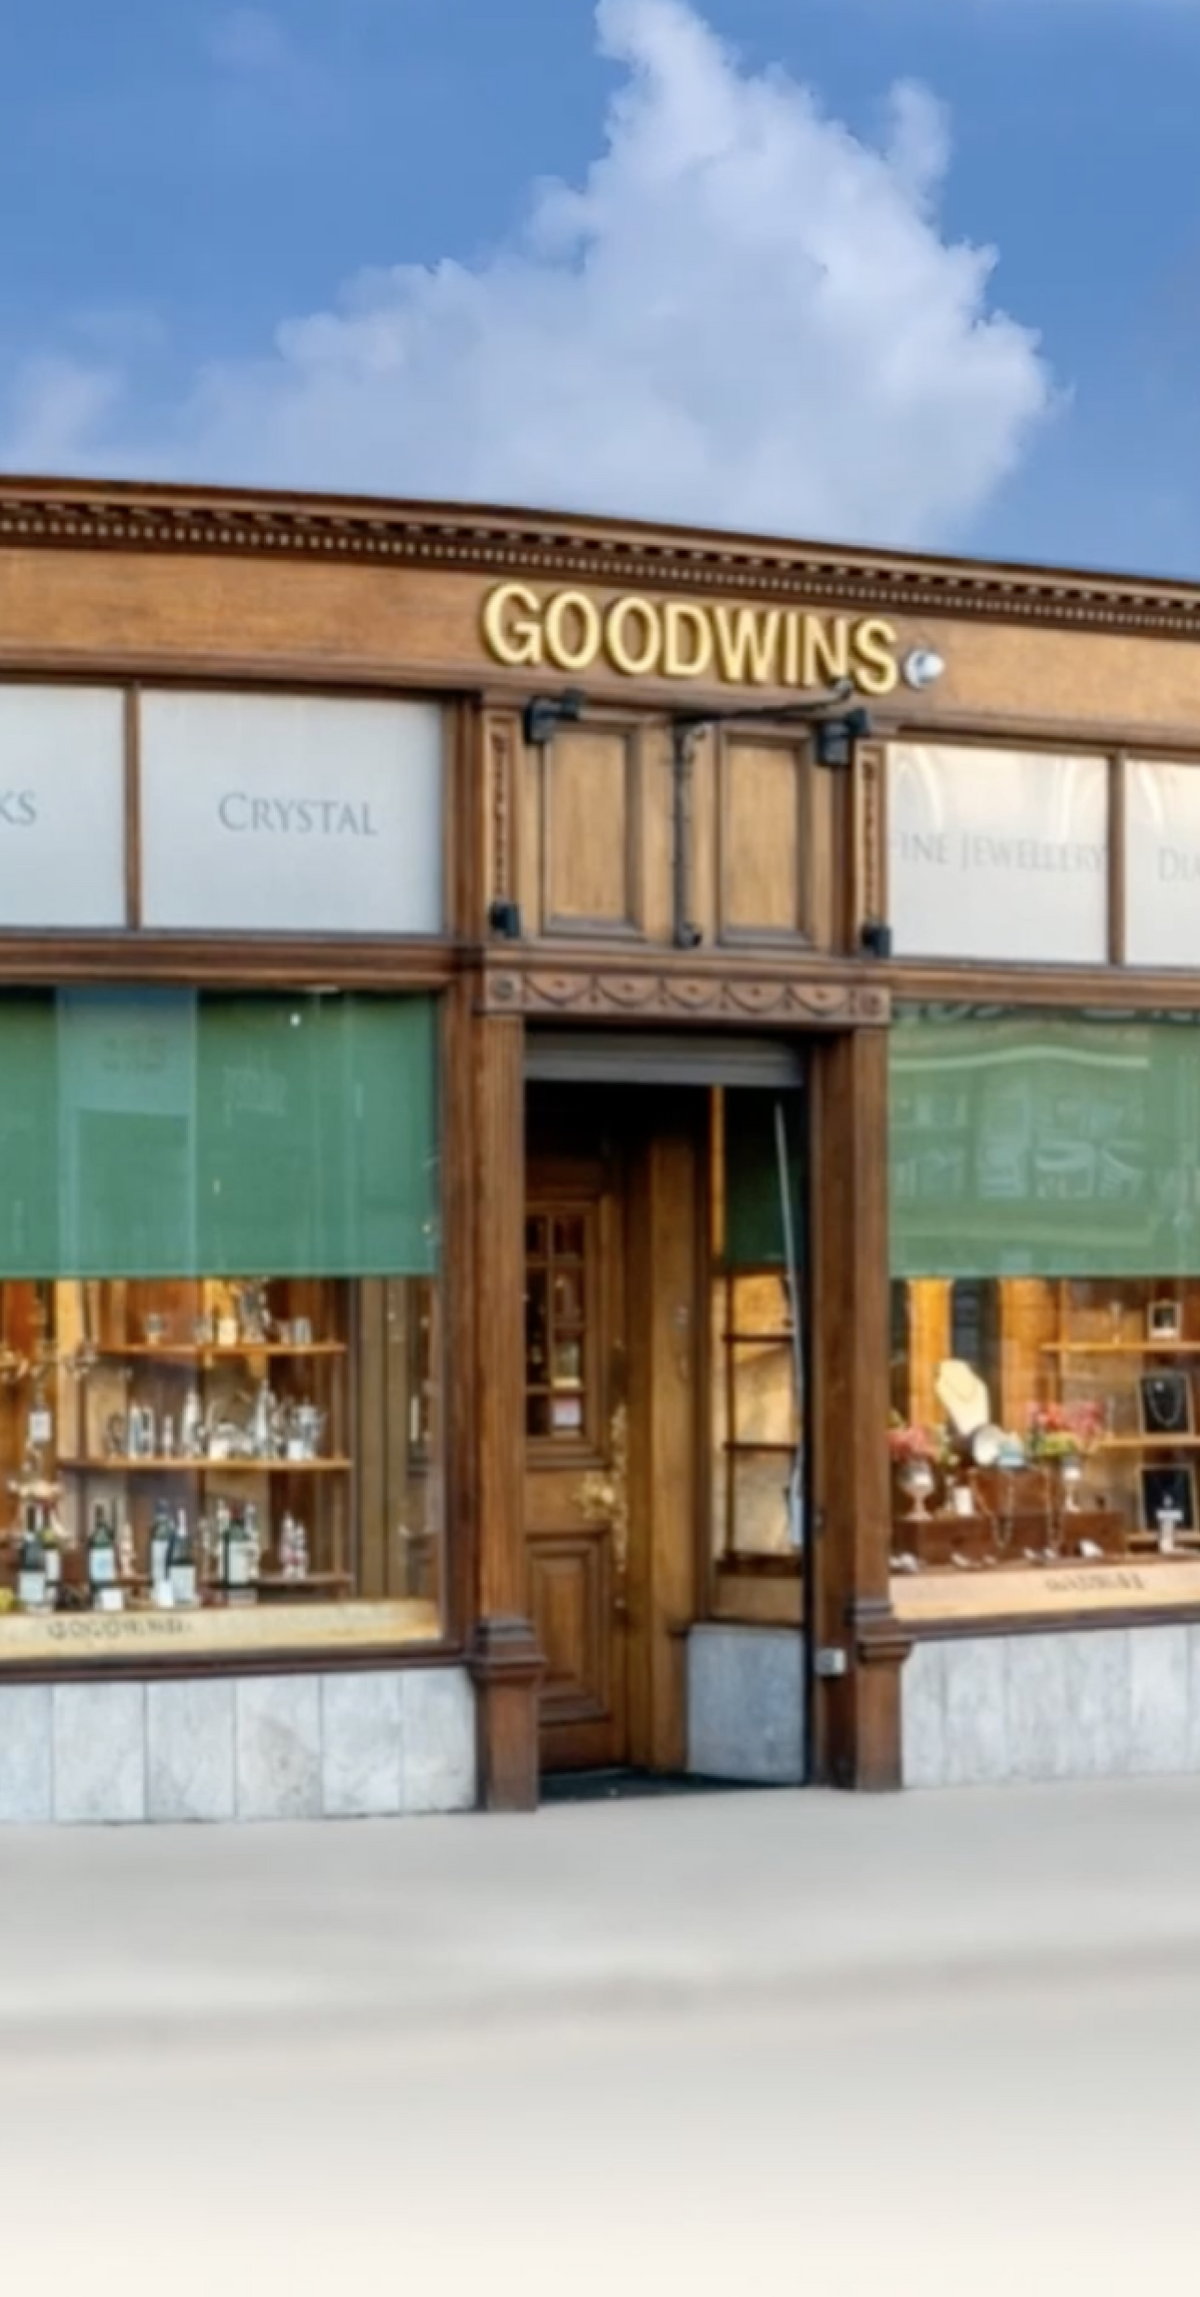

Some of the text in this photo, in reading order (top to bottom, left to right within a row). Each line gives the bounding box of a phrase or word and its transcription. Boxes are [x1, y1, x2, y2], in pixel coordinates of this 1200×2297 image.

[482, 582, 898, 695] GOODWINS
[218, 791, 378, 837] CRYSTAL
[892, 830, 951, 867] INE
